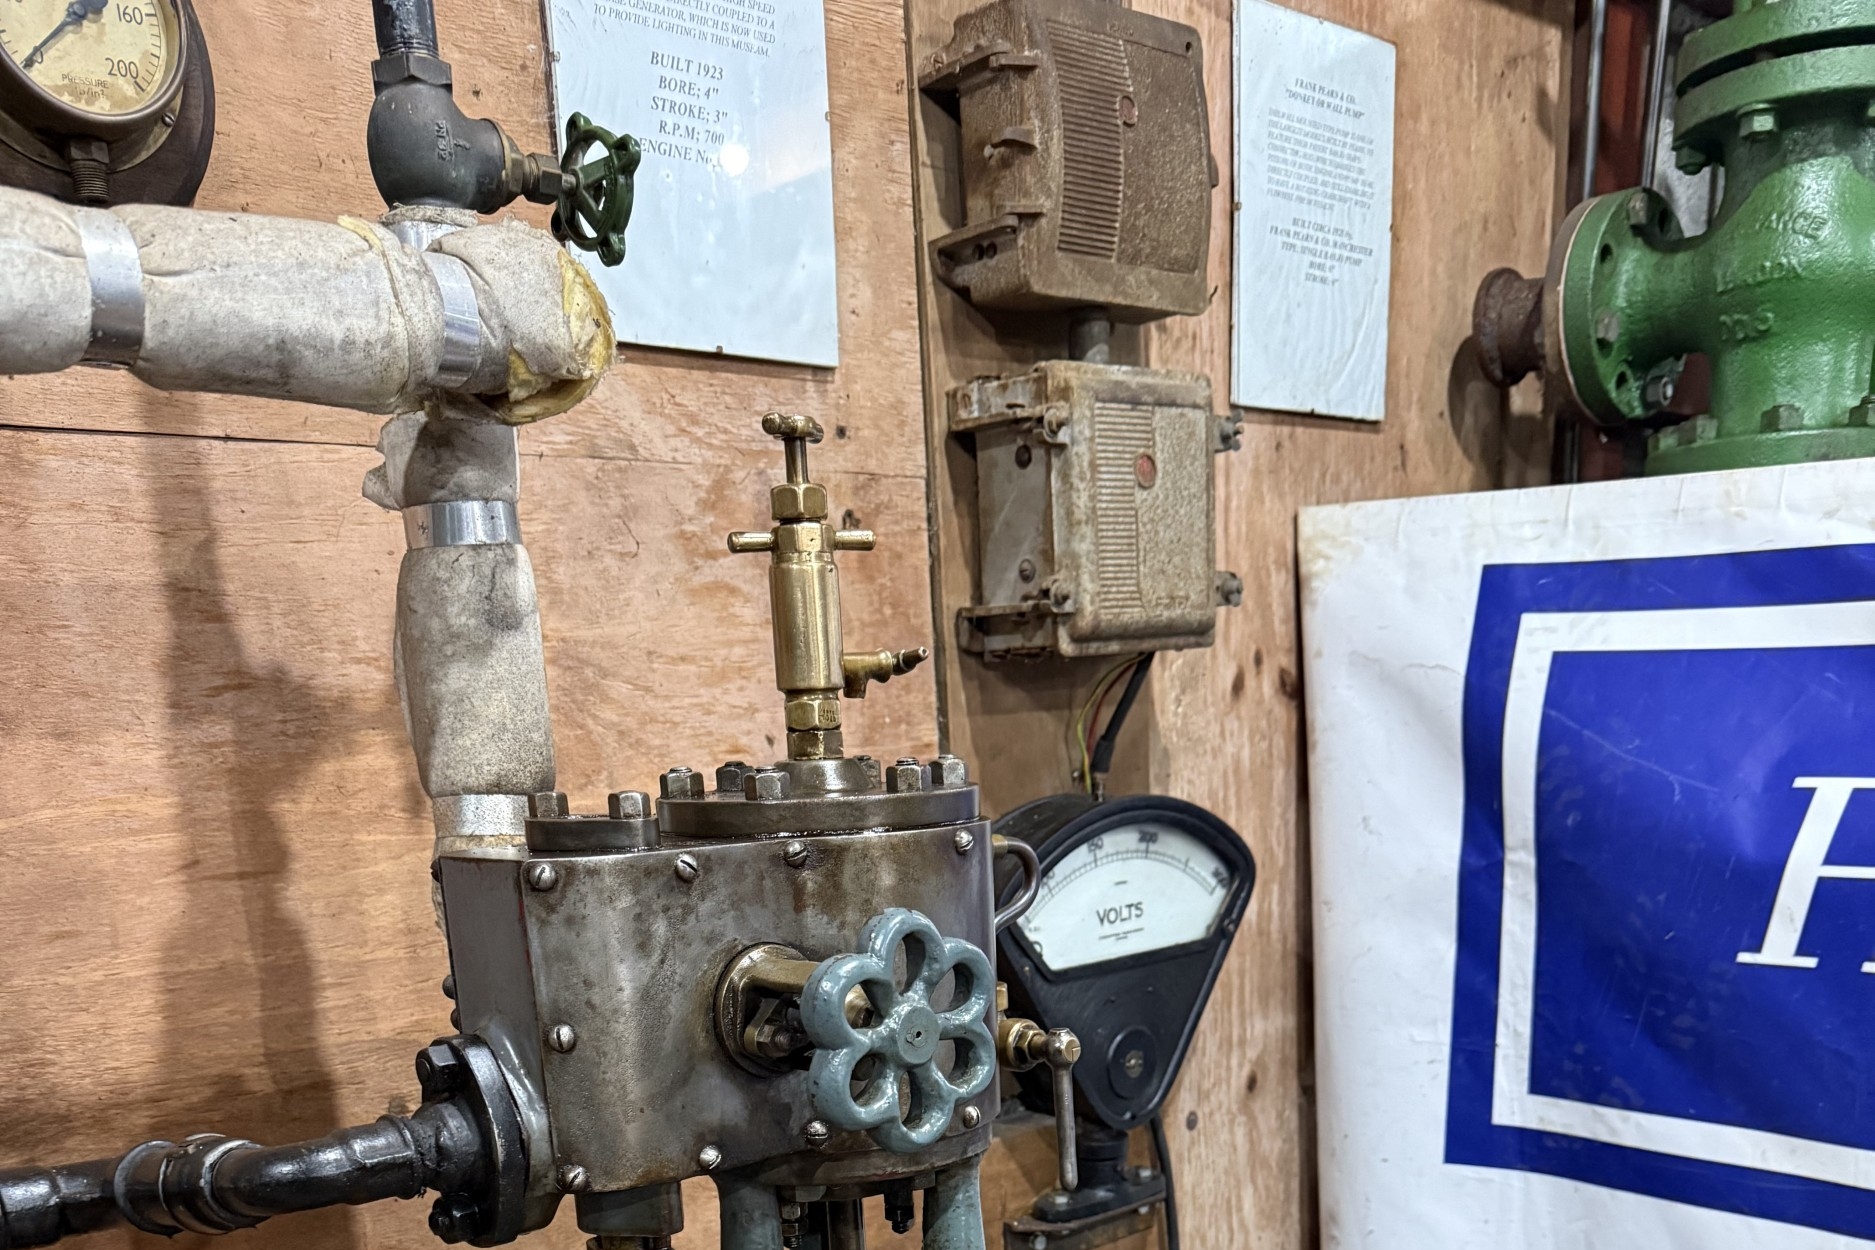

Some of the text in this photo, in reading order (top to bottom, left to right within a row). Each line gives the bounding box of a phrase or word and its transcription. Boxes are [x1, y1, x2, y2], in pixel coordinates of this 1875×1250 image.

[117, 4, 143, 25] 160
[712, 4, 754, 23] COUPLED
[757, 16, 768, 27] TO
[769, 20, 775, 30] A
[747, 0, 776, 15] SPEED
[594, 3, 606, 16] TO
[609, 7, 651, 27] PROVIDE
[652, 18, 697, 39] LIGHTING
[698, 29, 708, 41] IN
[710, 33, 730, 47] THIS
[689, 12, 719, 30] WHICH
[720, 21, 729, 32] IS
[731, 24, 751, 38] NOW
[753, 30, 776, 44] USED
[105, 57, 139, 80] 200
[650, 51, 724, 80] BUILT 1923
[61, 74, 109, 89] PRESSURE
[659, 75, 719, 100] BORE; 4"
[651, 96, 728, 124] STROKE; 3"
[659, 120, 725, 146] R.P.M; 700
[639, 137, 692, 161] ENGINE
[1096, 902, 1144, 928] VOLTS
